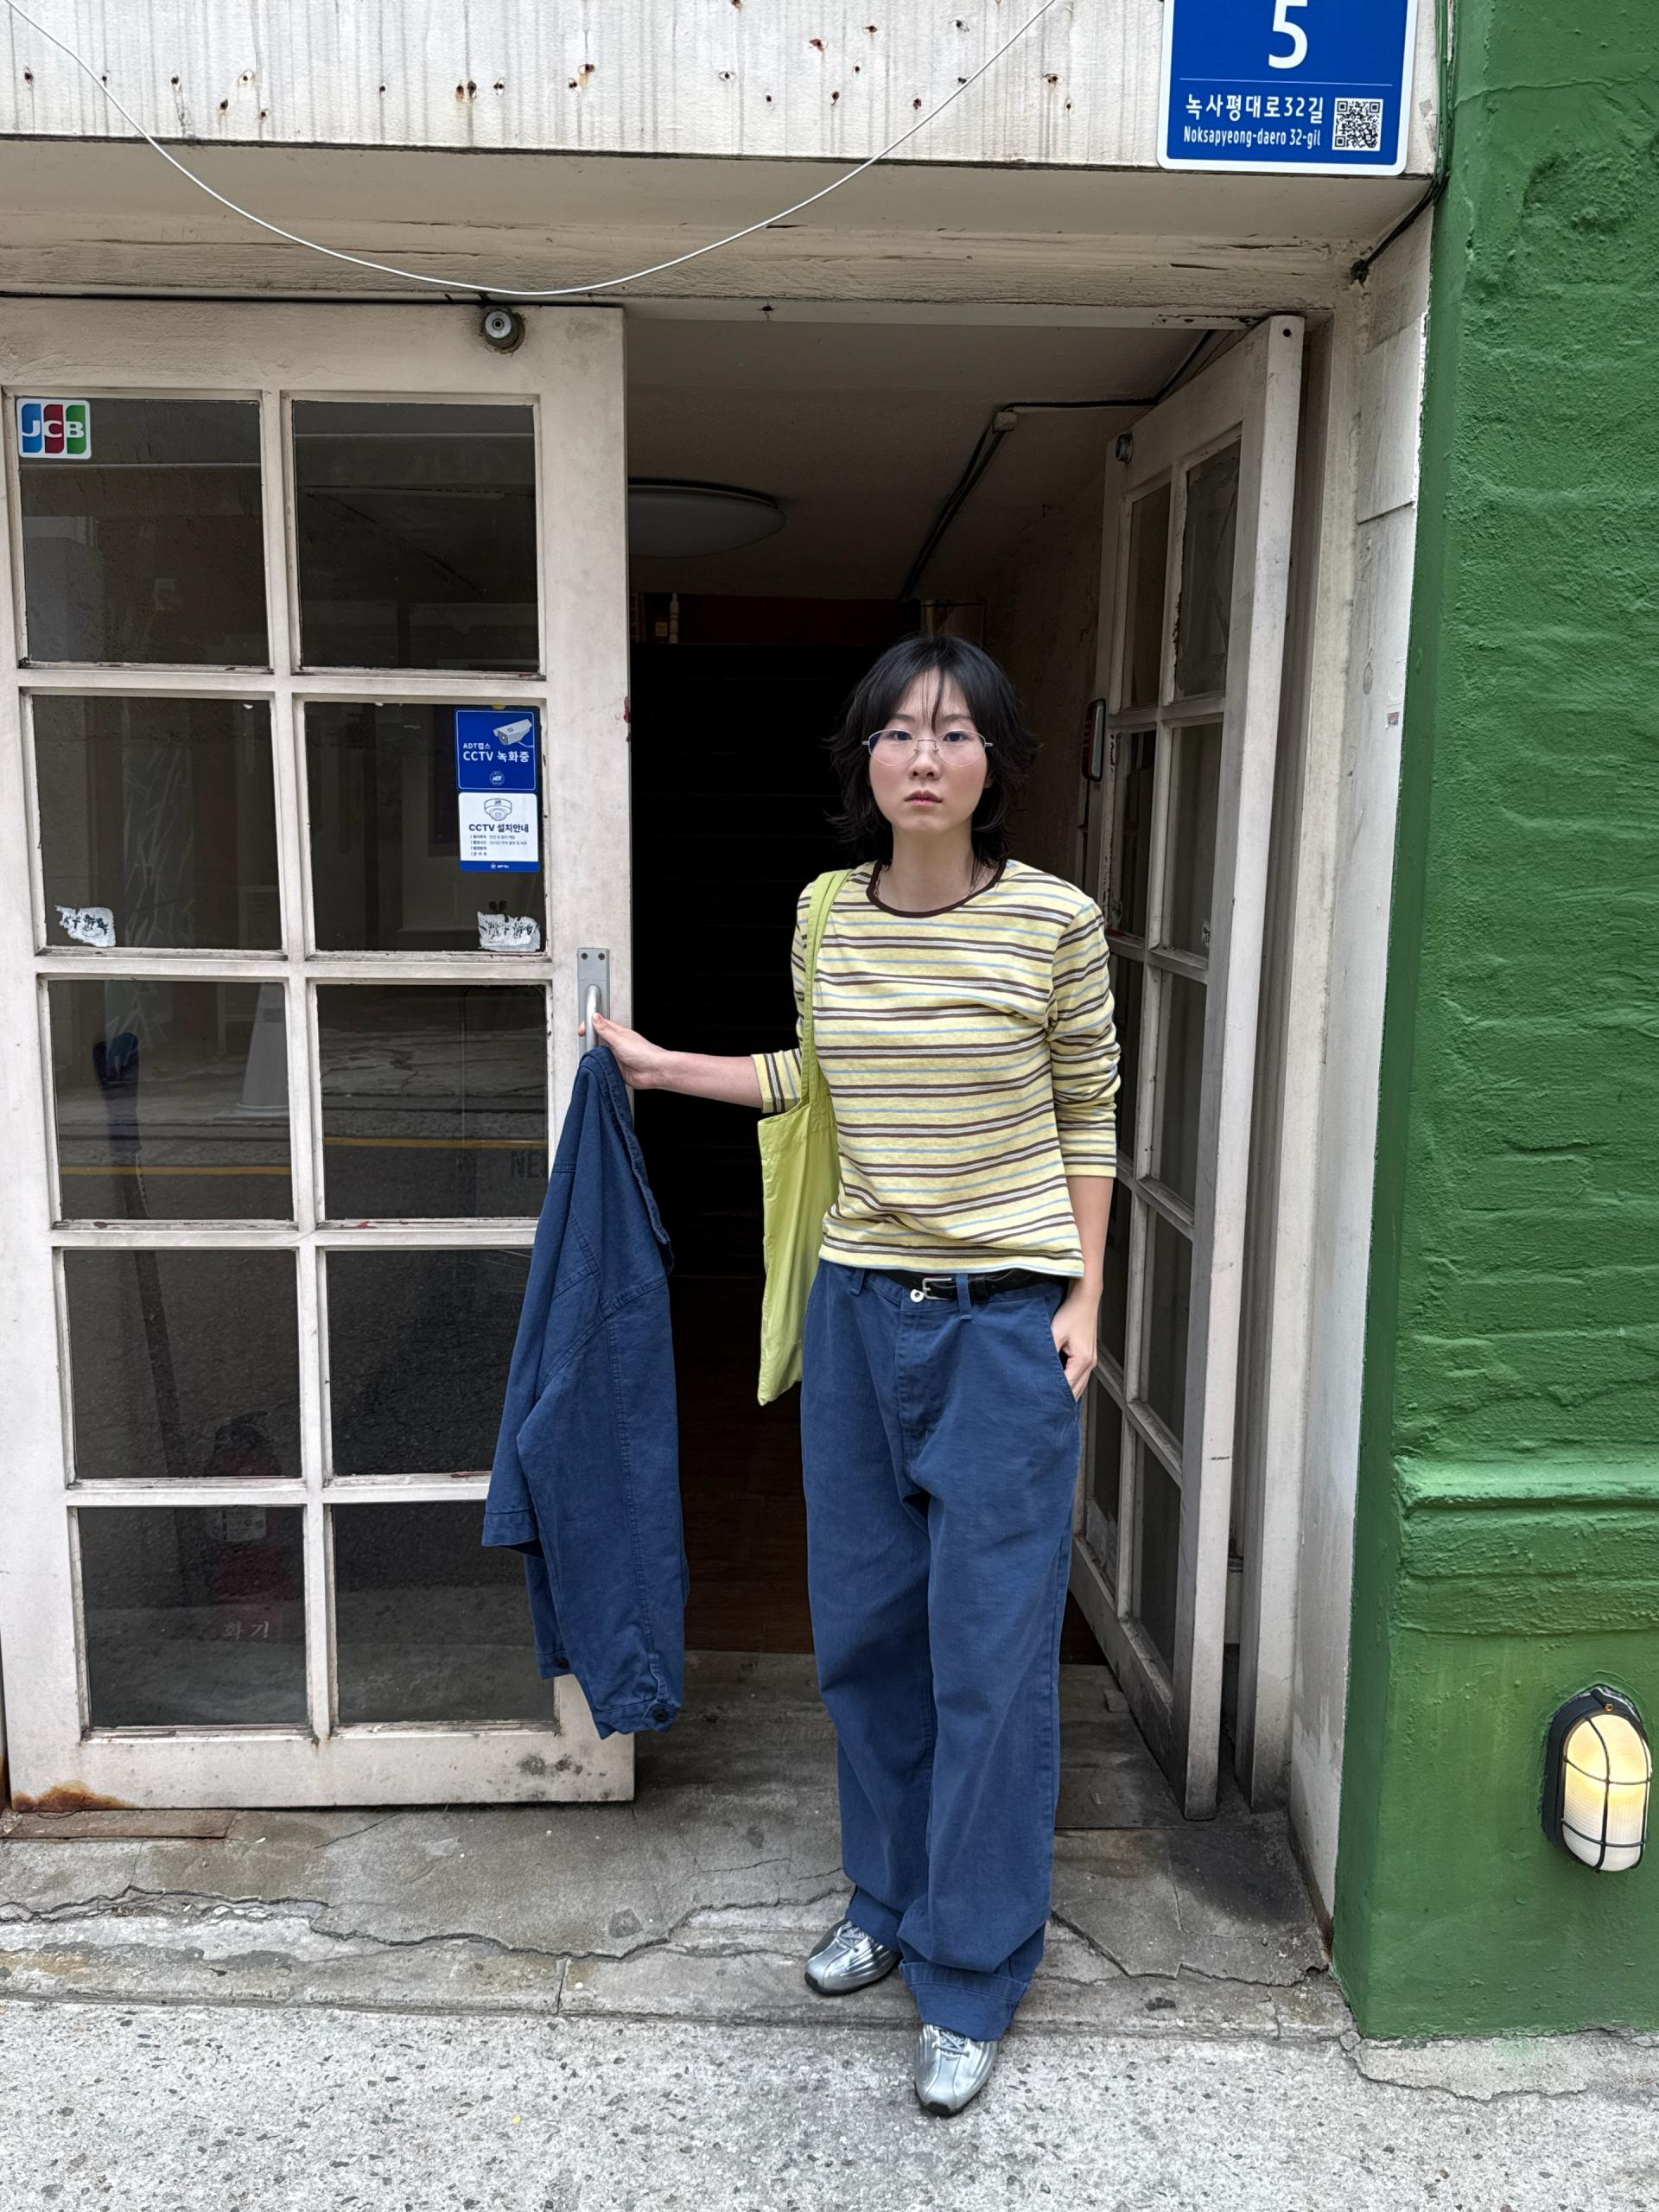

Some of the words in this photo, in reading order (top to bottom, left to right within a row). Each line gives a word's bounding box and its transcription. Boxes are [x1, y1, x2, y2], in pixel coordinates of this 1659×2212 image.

[1268, 0, 1308, 69] 5
[1185, 94, 1324, 124] 녹사평대로32길
[1183, 125, 1287, 148] Noksapyeong-daero
[1289, 128, 1321, 149] 32-gil
[21, 420, 85, 438] JCB
[463, 751, 493, 761] CCTV
[497, 750, 530, 763] 녹화중
[468, 823, 495, 832] CCTV
[497, 823, 529, 833] 설치안내
